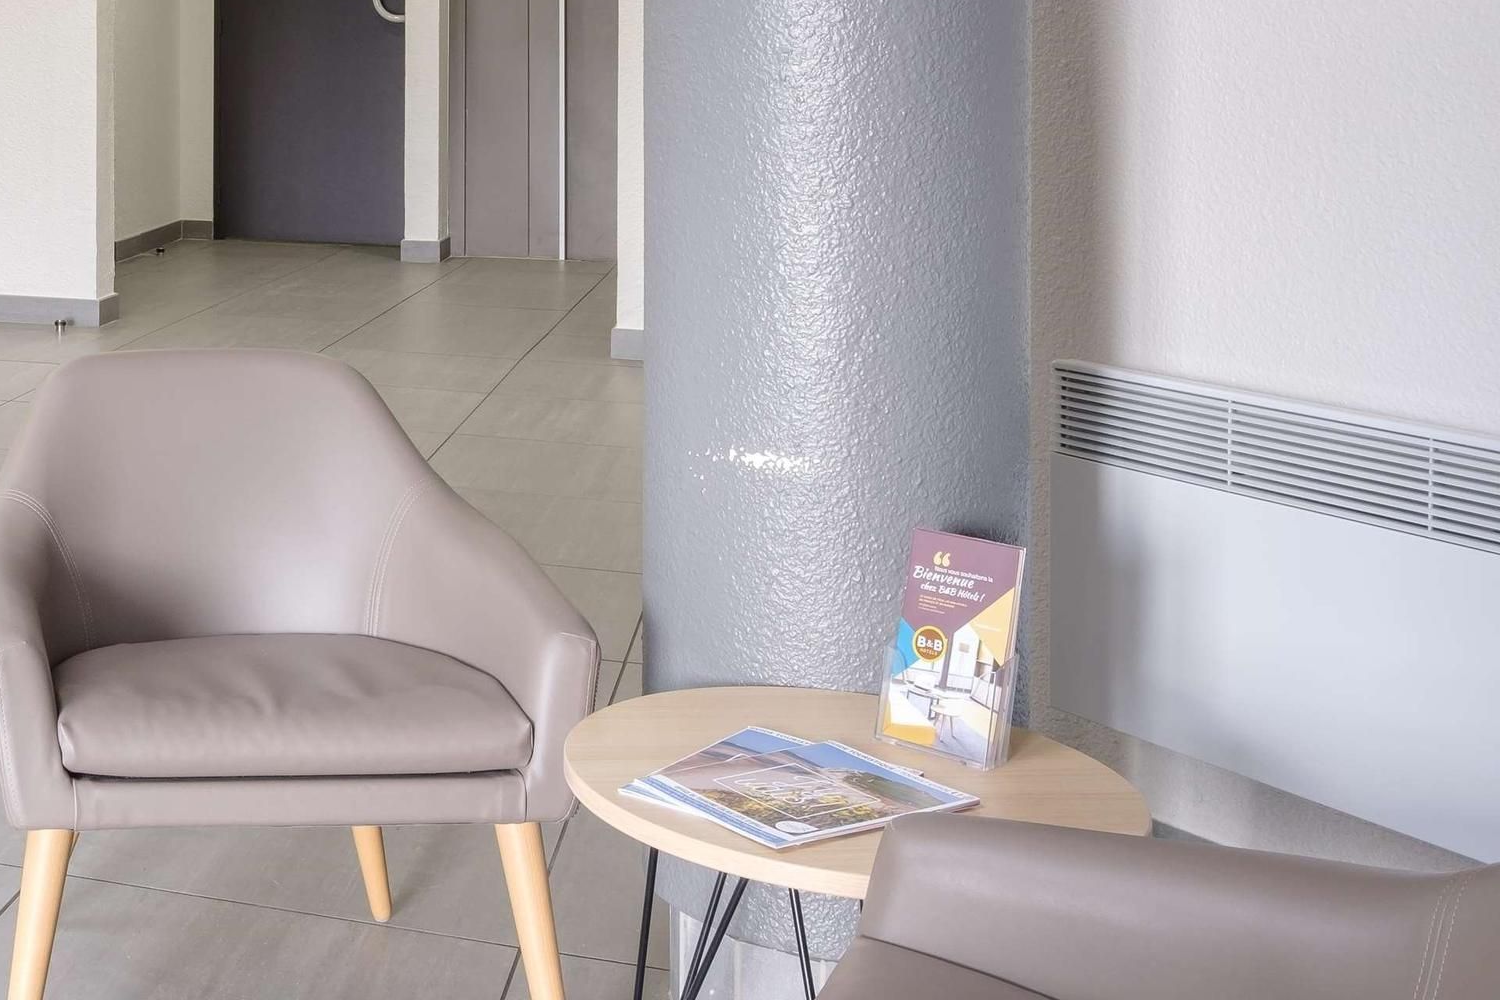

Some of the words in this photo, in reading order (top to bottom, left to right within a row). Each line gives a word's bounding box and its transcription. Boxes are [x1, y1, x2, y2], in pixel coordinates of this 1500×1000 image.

[913, 565, 975, 589] Bienvenue
[920, 581, 938, 592] chez
[938, 584, 957, 596] B&B
[917, 635, 943, 652] B&B
